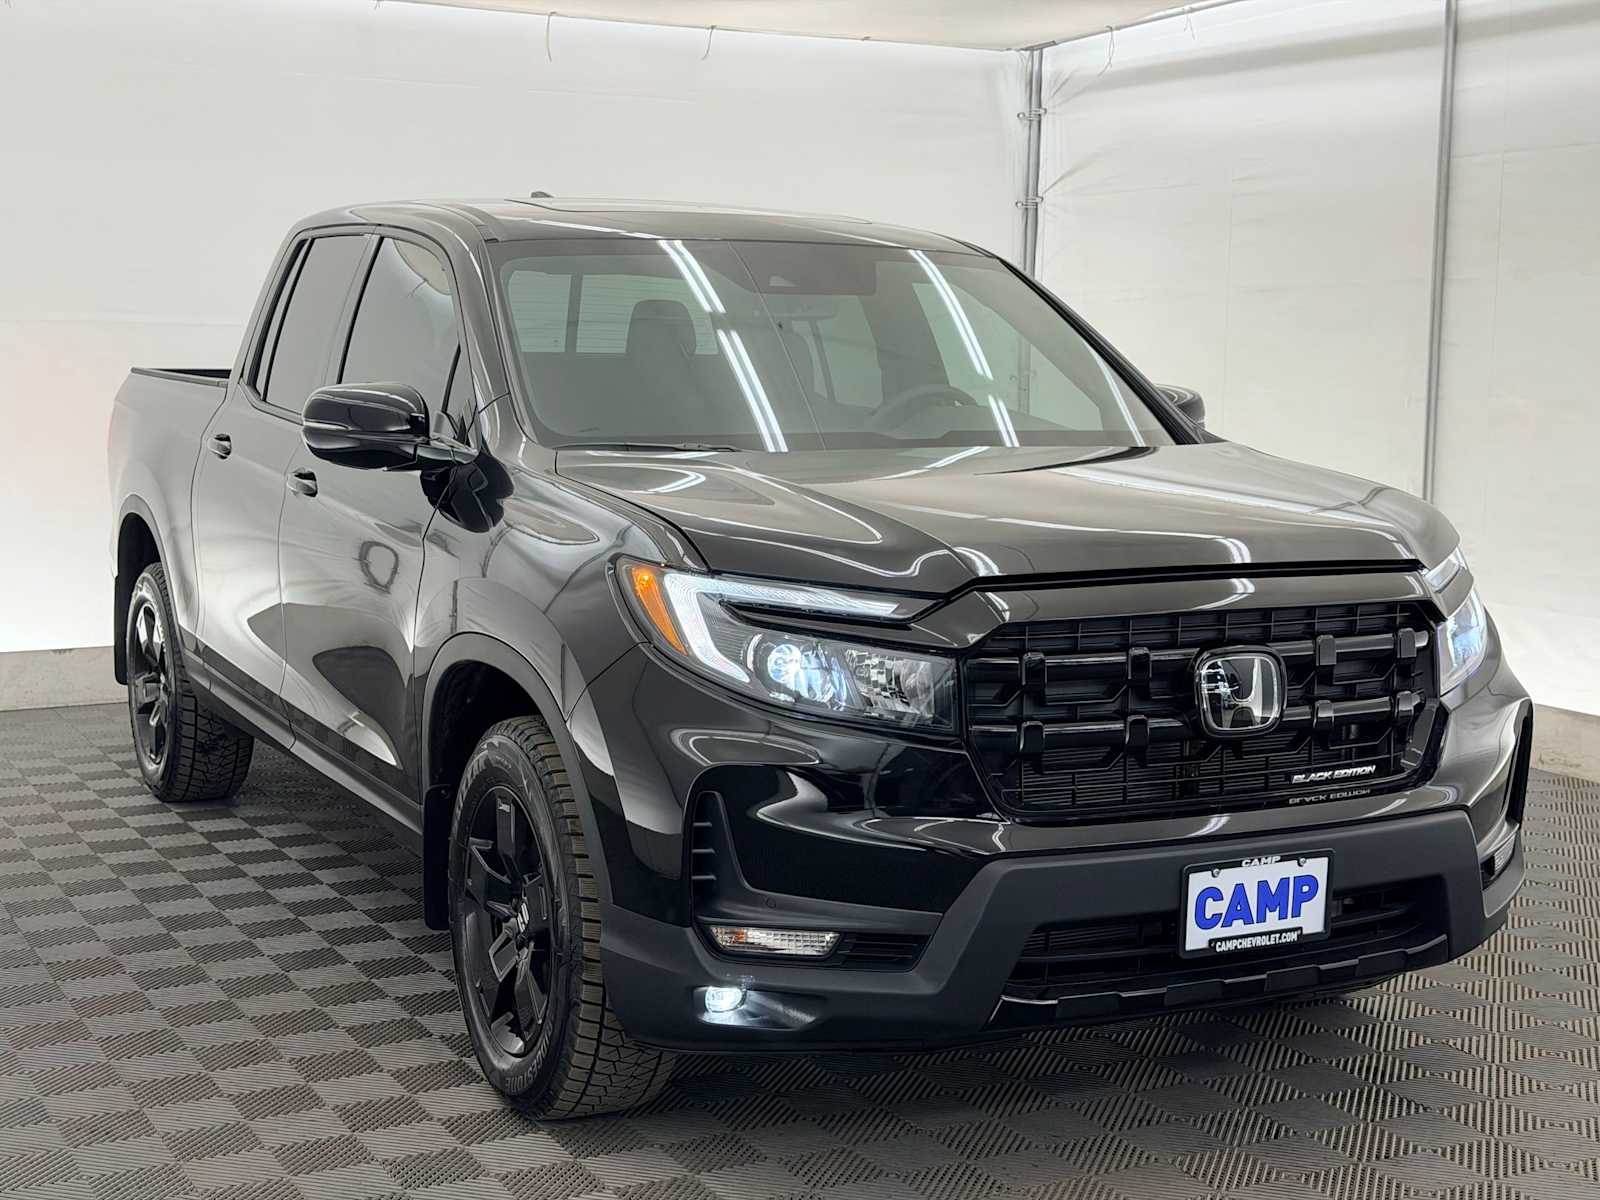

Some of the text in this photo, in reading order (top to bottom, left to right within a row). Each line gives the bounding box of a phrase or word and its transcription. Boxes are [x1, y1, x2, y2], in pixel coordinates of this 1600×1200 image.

[1292, 764, 1376, 784] BLACK EDITION
[1241, 855, 1281, 868] CAMP
[1194, 874, 1319, 930] CAMP
[1215, 930, 1298, 952] CAMPCHEVROLET.COM
